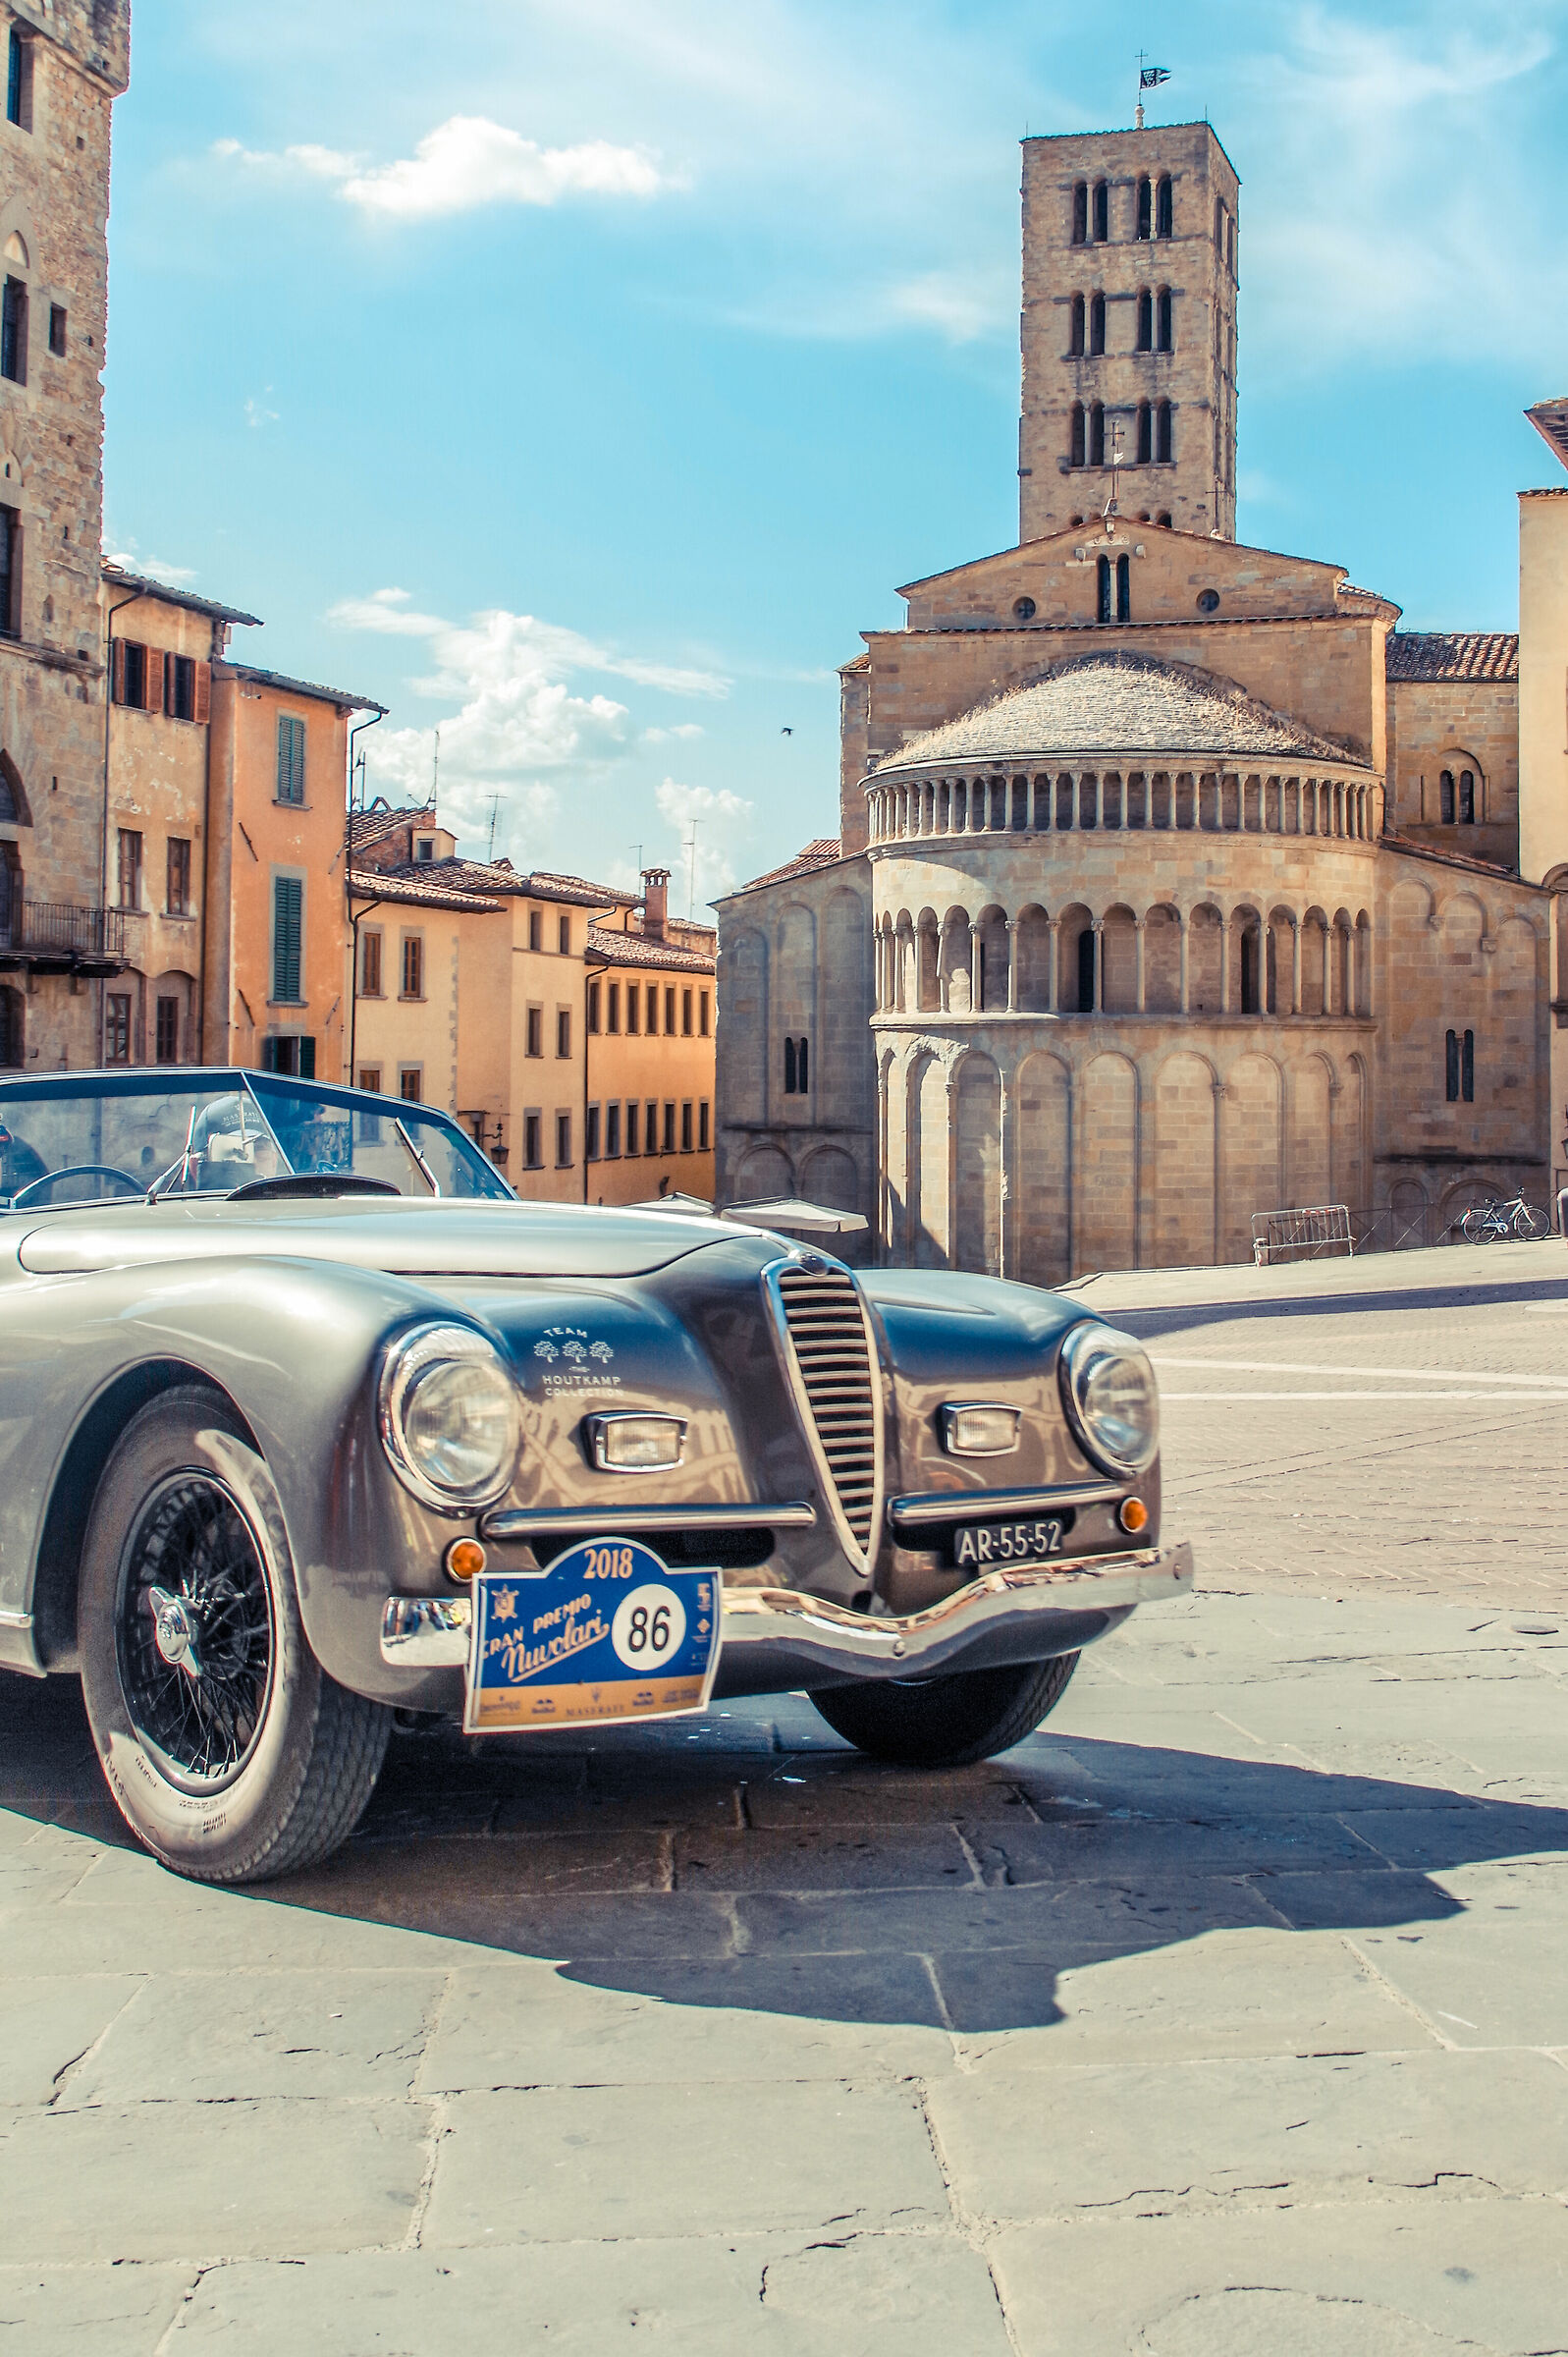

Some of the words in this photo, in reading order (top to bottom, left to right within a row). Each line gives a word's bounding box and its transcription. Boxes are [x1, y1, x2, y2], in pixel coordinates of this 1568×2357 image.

[543, 1327, 588, 1339] TEAM
[542, 1375, 622, 1386] HOUTKAMP
[544, 1388, 624, 1398] COLLECTION
[957, 1520, 1061, 1564] AR-55-52
[583, 1548, 633, 1579] 2018
[532, 1593, 591, 1634] PREMIO
[628, 1605, 672, 1653] 86
[501, 1609, 603, 1680] Nuvolari
